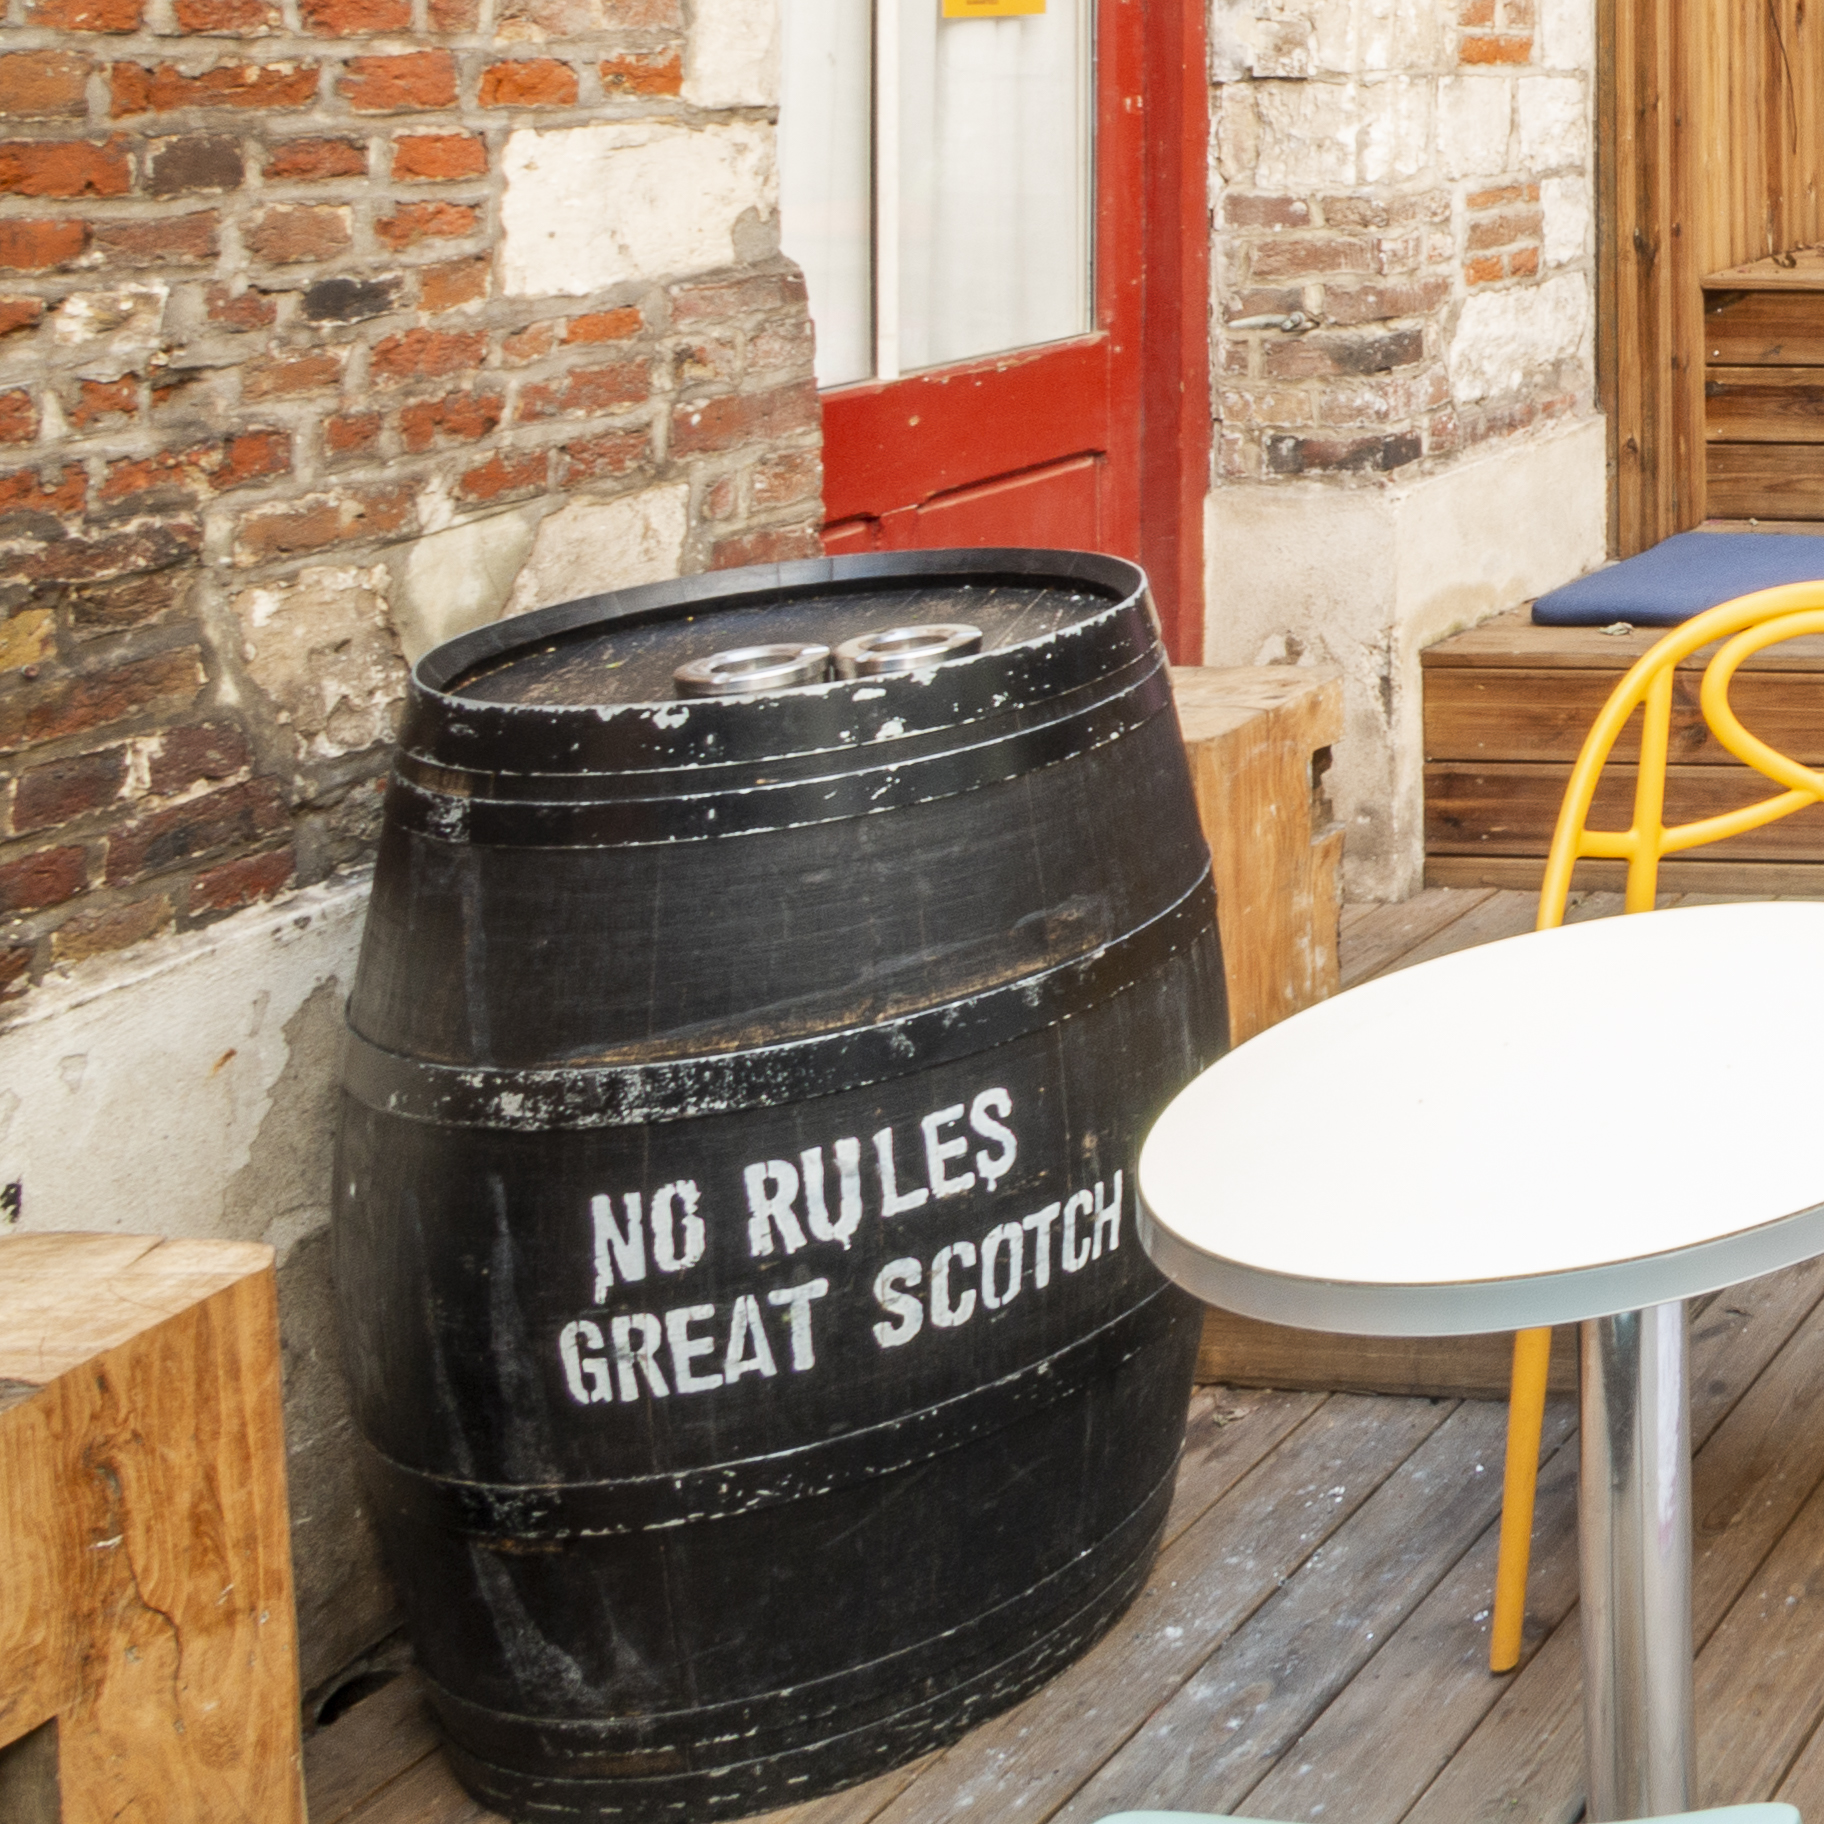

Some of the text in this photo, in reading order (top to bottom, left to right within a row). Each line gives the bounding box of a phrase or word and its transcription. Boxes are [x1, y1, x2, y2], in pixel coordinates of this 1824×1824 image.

[559, 1169, 1123, 1405] GREAT SCOTCH
[591, 1087, 1018, 1305] NO RULES
